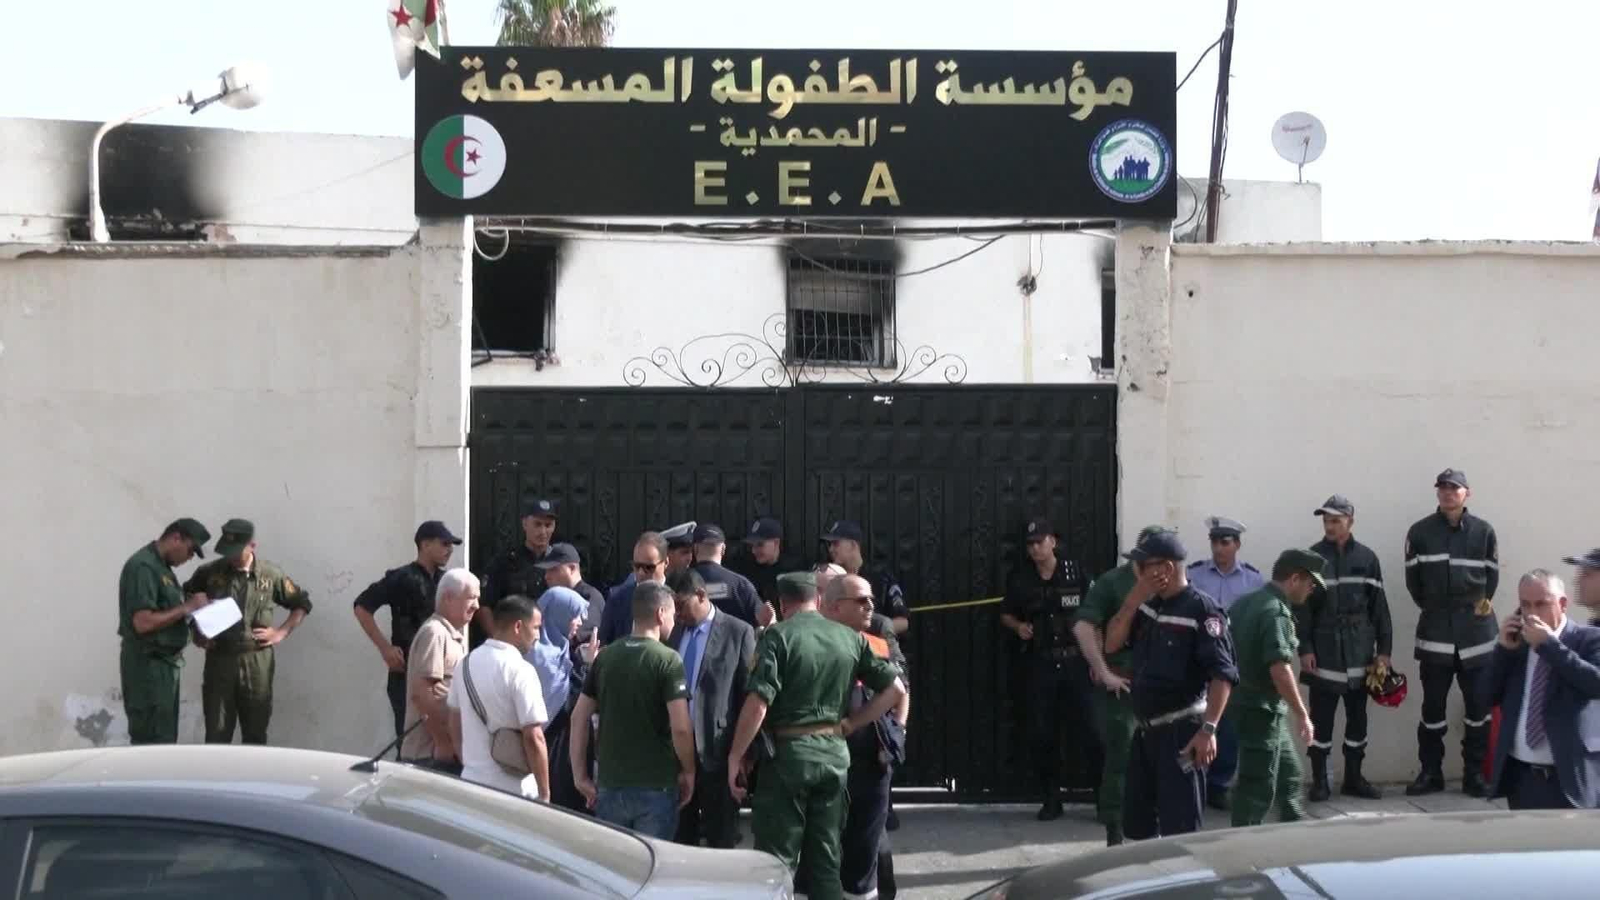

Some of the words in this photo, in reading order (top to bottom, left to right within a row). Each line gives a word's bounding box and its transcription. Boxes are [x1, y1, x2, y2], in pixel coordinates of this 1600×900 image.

[460, 55, 694, 104] المسعفة
[710, 56, 918, 120] الطفولة
[935, 59, 1134, 121] مؤسسة
[719, 117, 878, 157] المحمدية
